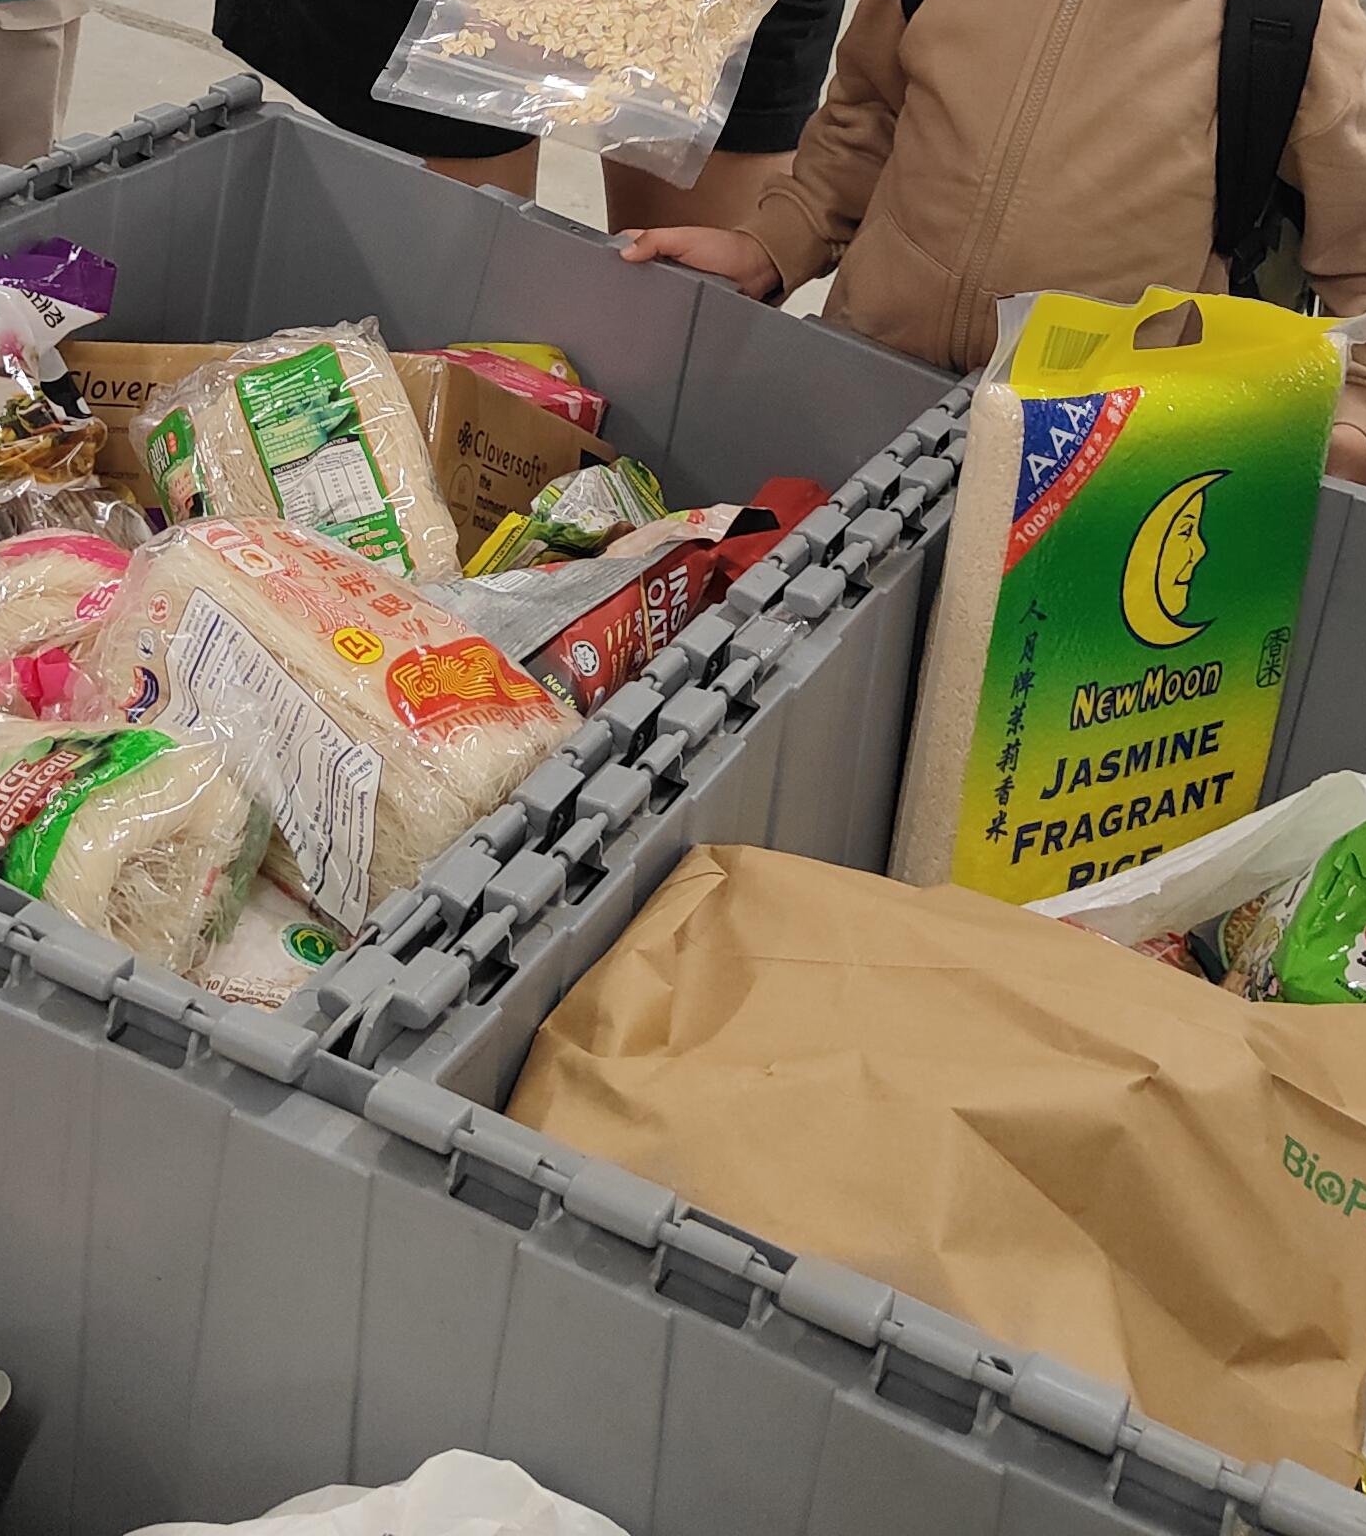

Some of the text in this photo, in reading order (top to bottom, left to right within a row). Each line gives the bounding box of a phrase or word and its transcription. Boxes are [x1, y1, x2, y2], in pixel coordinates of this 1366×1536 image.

[1027, 448, 1076, 504] PREMIUM
[1014, 500, 1061, 544] 100%
[542, 673, 567, 696] Net
